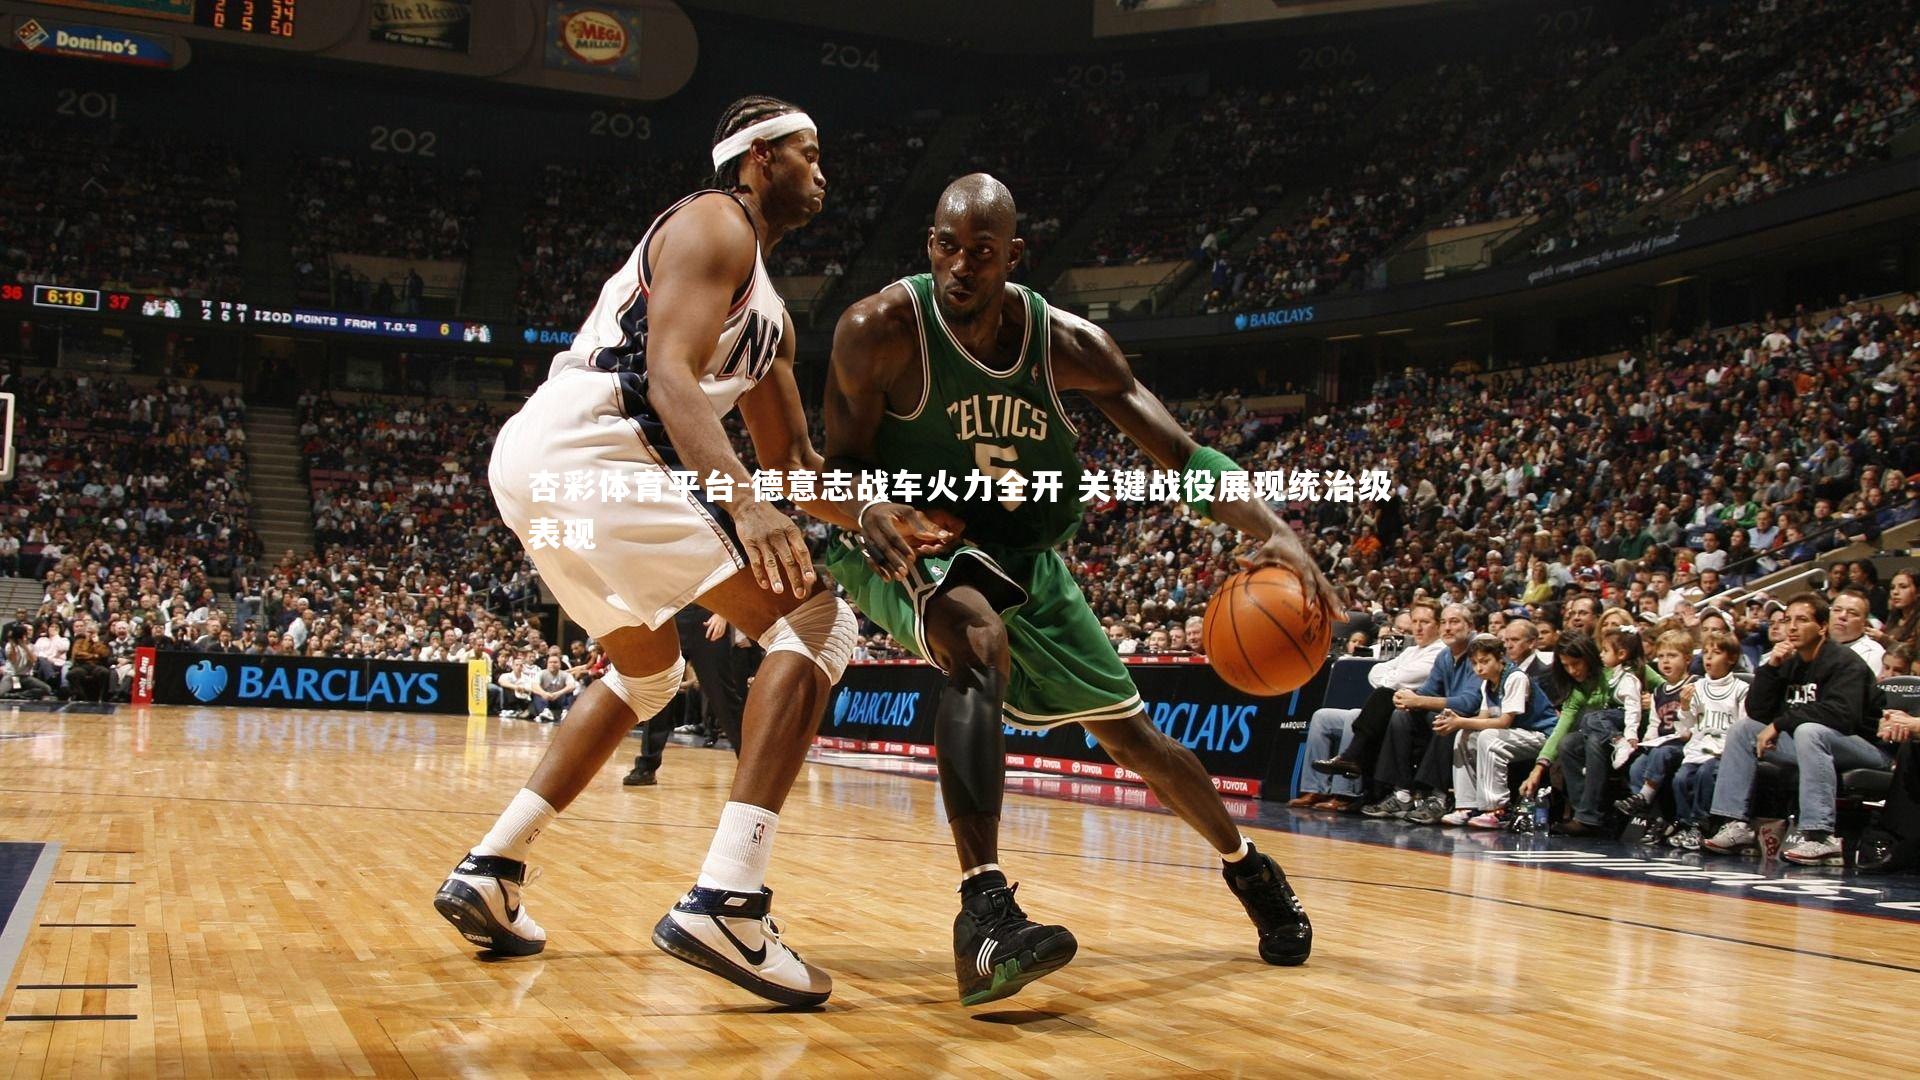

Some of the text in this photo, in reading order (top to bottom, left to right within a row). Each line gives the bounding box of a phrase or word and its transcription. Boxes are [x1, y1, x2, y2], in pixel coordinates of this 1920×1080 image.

[56, 30, 138, 56] Domino's
[578, 21, 622, 41] MEGA
[820, 42, 880, 72] 204
[1066, 63, 1126, 87] 205
[56, 88, 118, 119] 201
[590, 110, 650, 140] 203
[370, 125, 436, 158] 202
[47, 289, 85, 306] 6:19
[108, 294, 130, 310] 37
[202, 309, 212, 321] 2
[238, 312, 246, 323] 1
[254, 310, 293, 324] IZOD
[295, 314, 338, 326] POINTS
[344, 318, 377, 330] FROM
[440, 323, 450, 336] 6
[1250, 306, 1314, 327] BARCLAYS
[540, 330, 577, 344] BARC
[716, 308, 782, 383] NE
[238, 665, 438, 705] BARCLAYS
[846, 691, 920, 727] BARCLAYS
[1143, 701, 1258, 753] RCLAYS
[1042, 760, 1062, 769] TOYOTA
[1081, 764, 1103, 775] TOYOTA
[1222, 780, 1249, 791] TOYOTA
